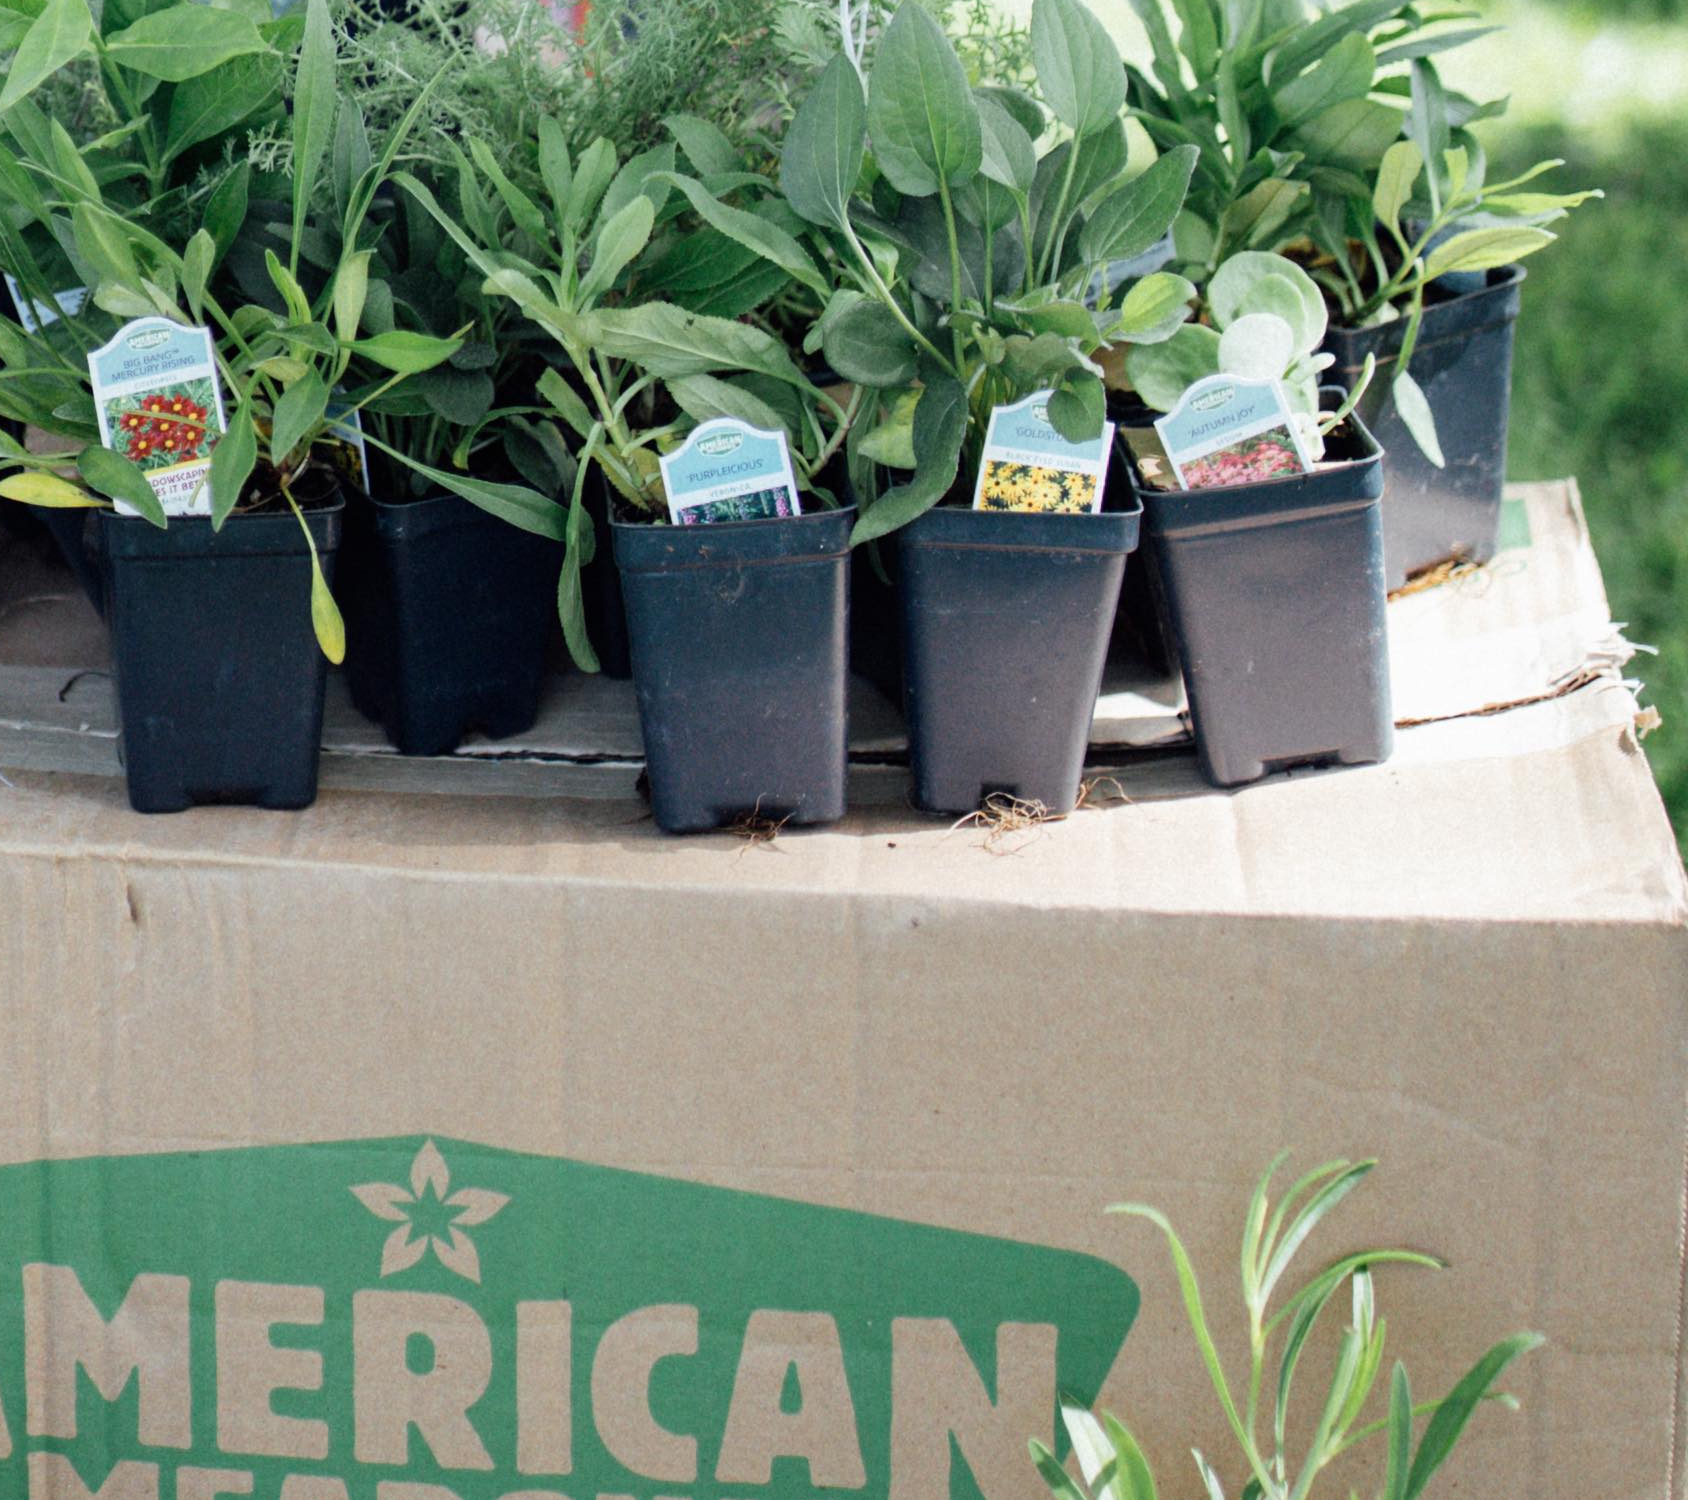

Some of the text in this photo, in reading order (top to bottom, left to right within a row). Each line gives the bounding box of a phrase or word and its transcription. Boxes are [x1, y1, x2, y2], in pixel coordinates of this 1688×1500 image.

[111, 354, 195, 383] MERCURY RISING
[124, 356, 141, 370] BIG
